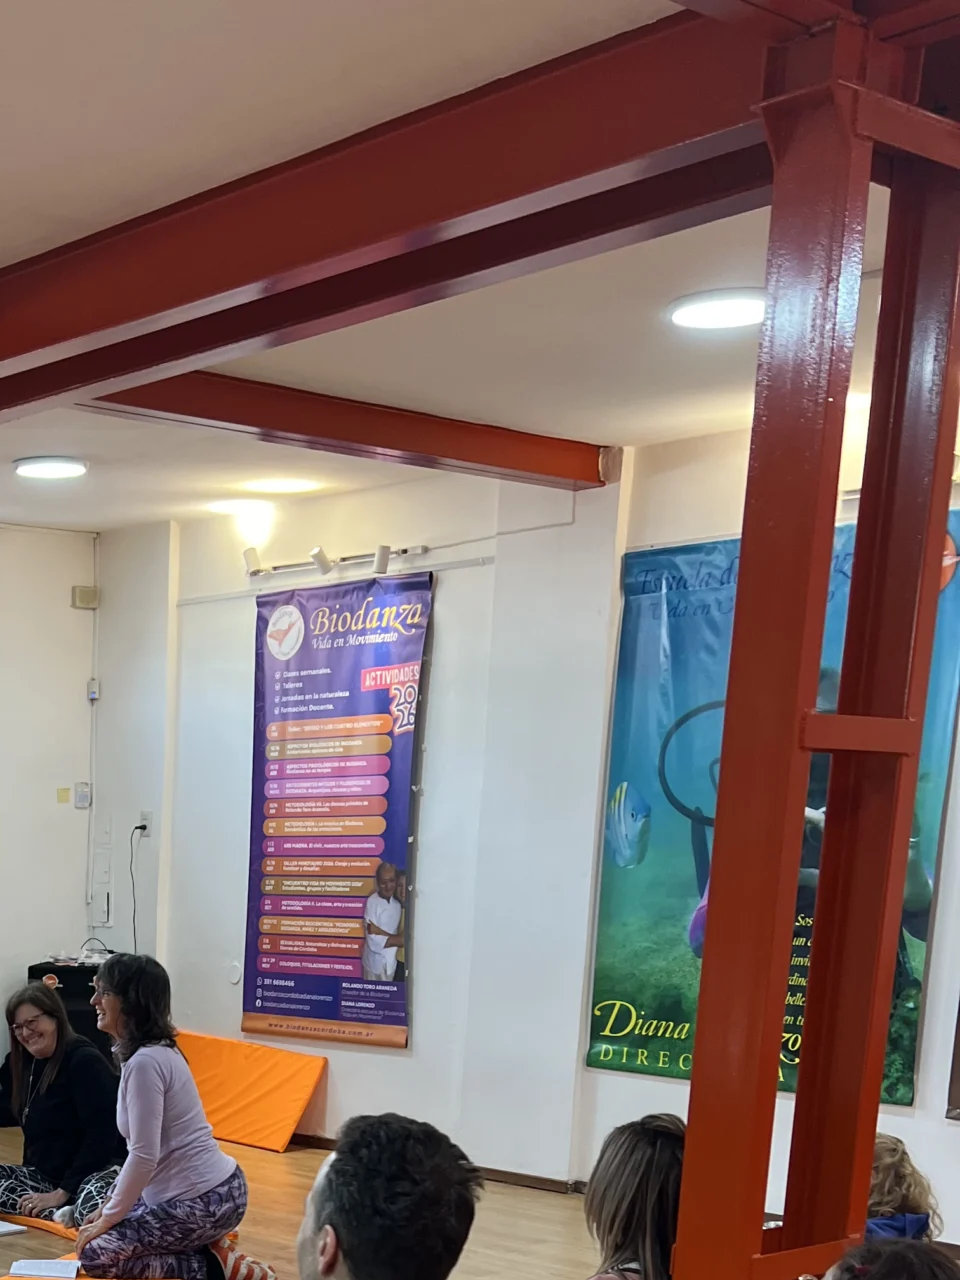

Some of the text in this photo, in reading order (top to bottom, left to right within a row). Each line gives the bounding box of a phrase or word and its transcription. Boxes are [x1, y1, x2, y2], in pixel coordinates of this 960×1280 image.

[310, 597, 422, 635] Biodanza
[312, 630, 398, 650] Vida en Movimiento
[365, 666, 419, 687] ACTIVIDADES
[594, 1000, 690, 1040] Diana
